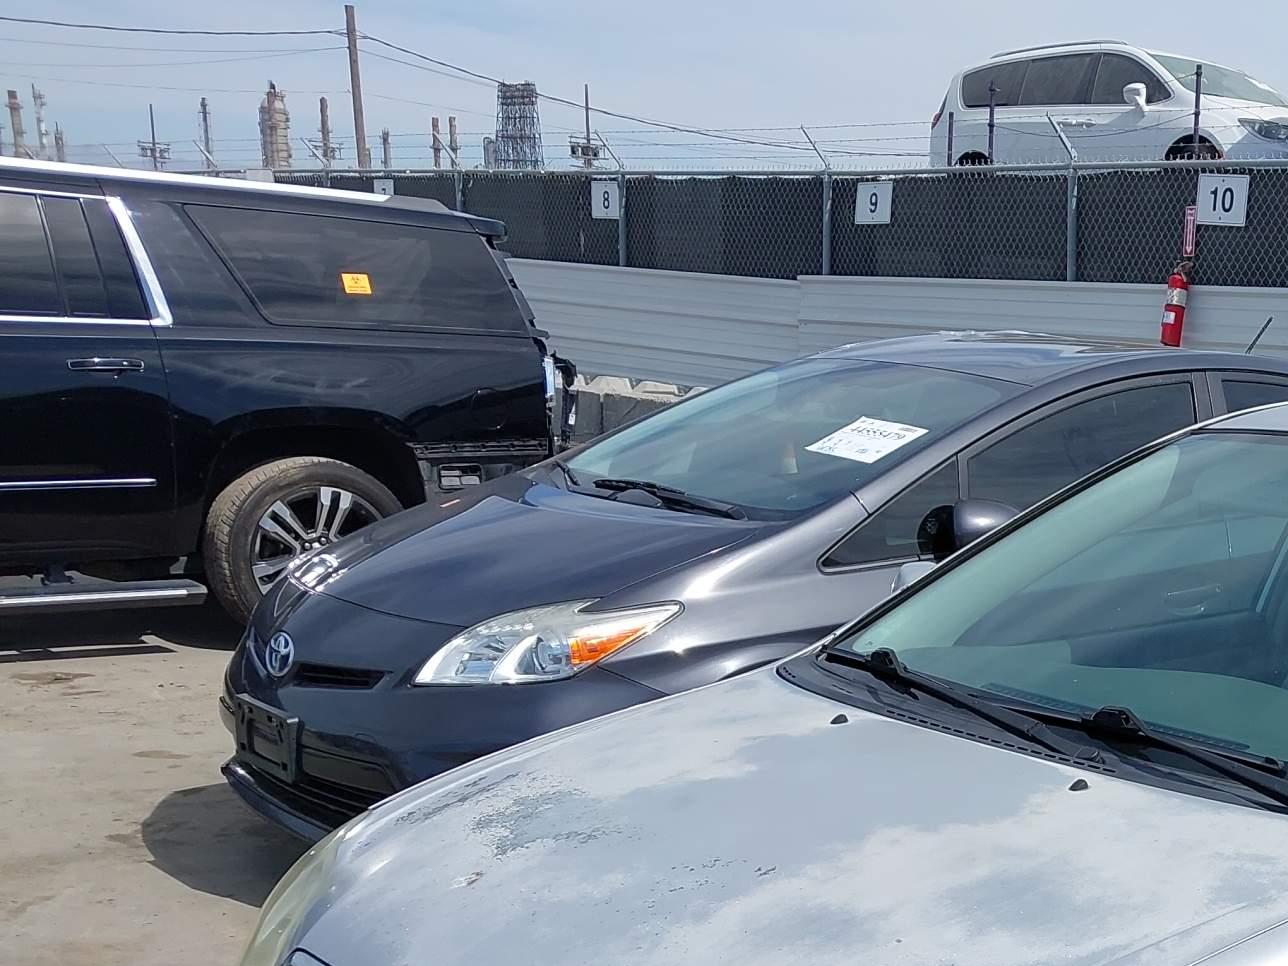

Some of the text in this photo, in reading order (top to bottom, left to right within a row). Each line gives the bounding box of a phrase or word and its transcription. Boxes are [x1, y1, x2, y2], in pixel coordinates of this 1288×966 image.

[602, 190, 610, 210] 8
[869, 192, 878, 213] 9
[1210, 186, 1234, 213] 10
